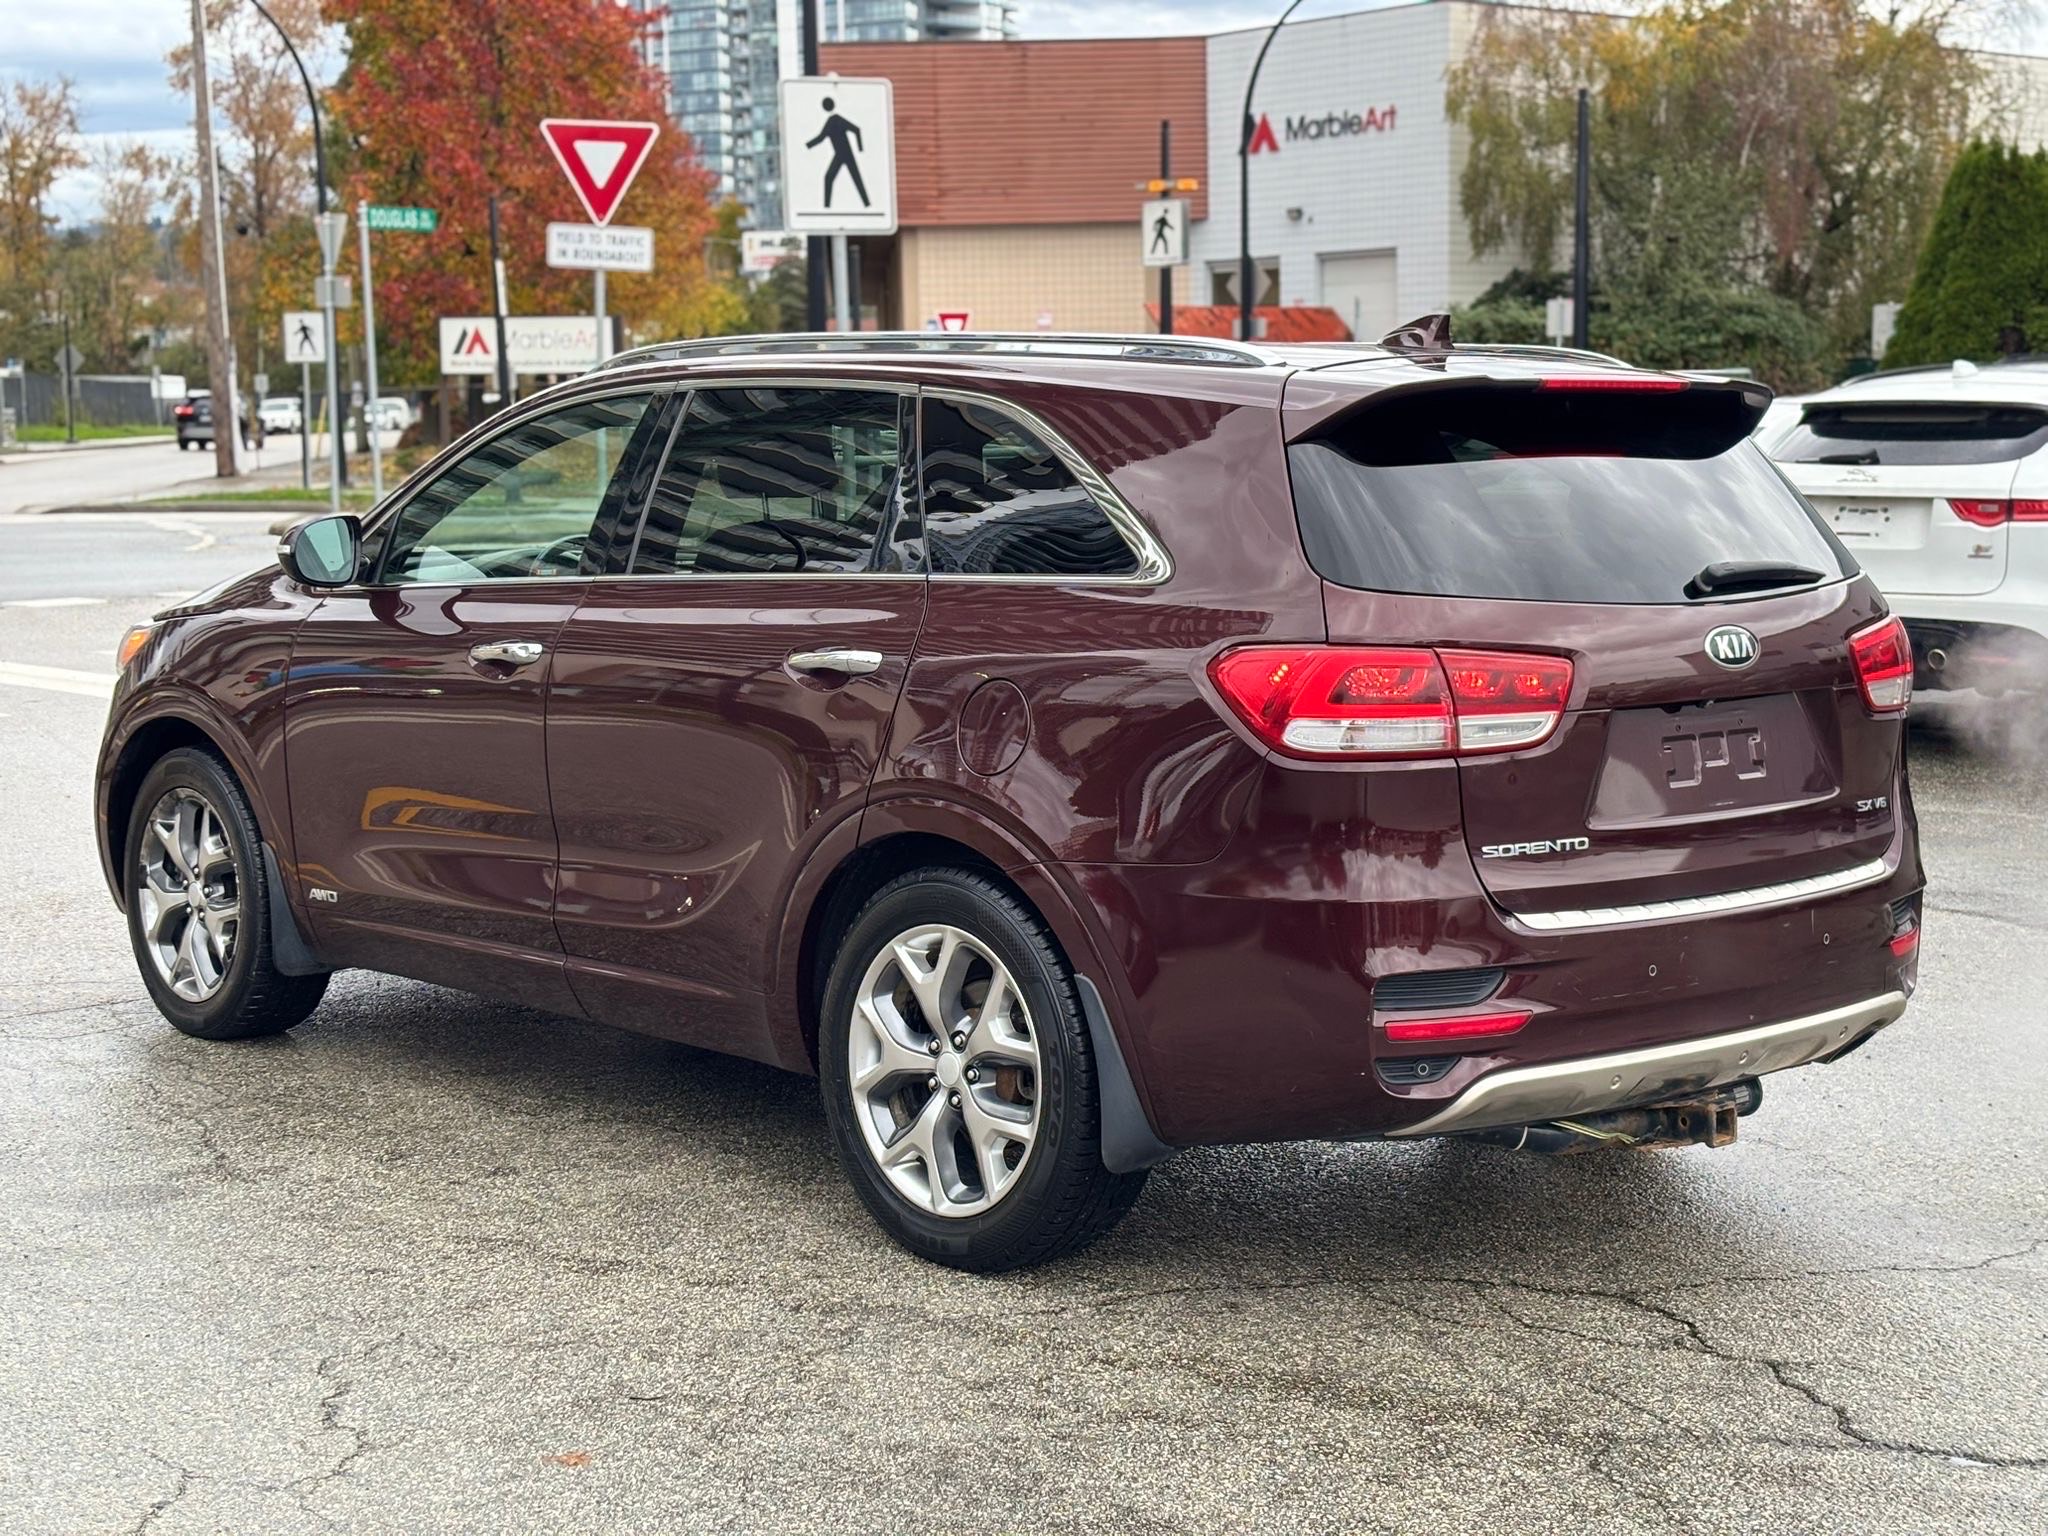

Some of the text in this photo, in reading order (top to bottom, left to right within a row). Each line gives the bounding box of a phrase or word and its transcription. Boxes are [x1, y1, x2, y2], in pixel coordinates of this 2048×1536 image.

[1286, 104, 1397, 142] MarbleArt
[370, 208, 418, 229] DOUGLAS
[557, 231, 645, 248] YIELD TO TRAFFIC
[573, 247, 645, 263] ROUNDABOUT
[1714, 634, 1754, 659] KIA
[1857, 796, 1887, 812] SX V6
[1481, 837, 1590, 859] SORENTO
[309, 888, 338, 903] AWD
